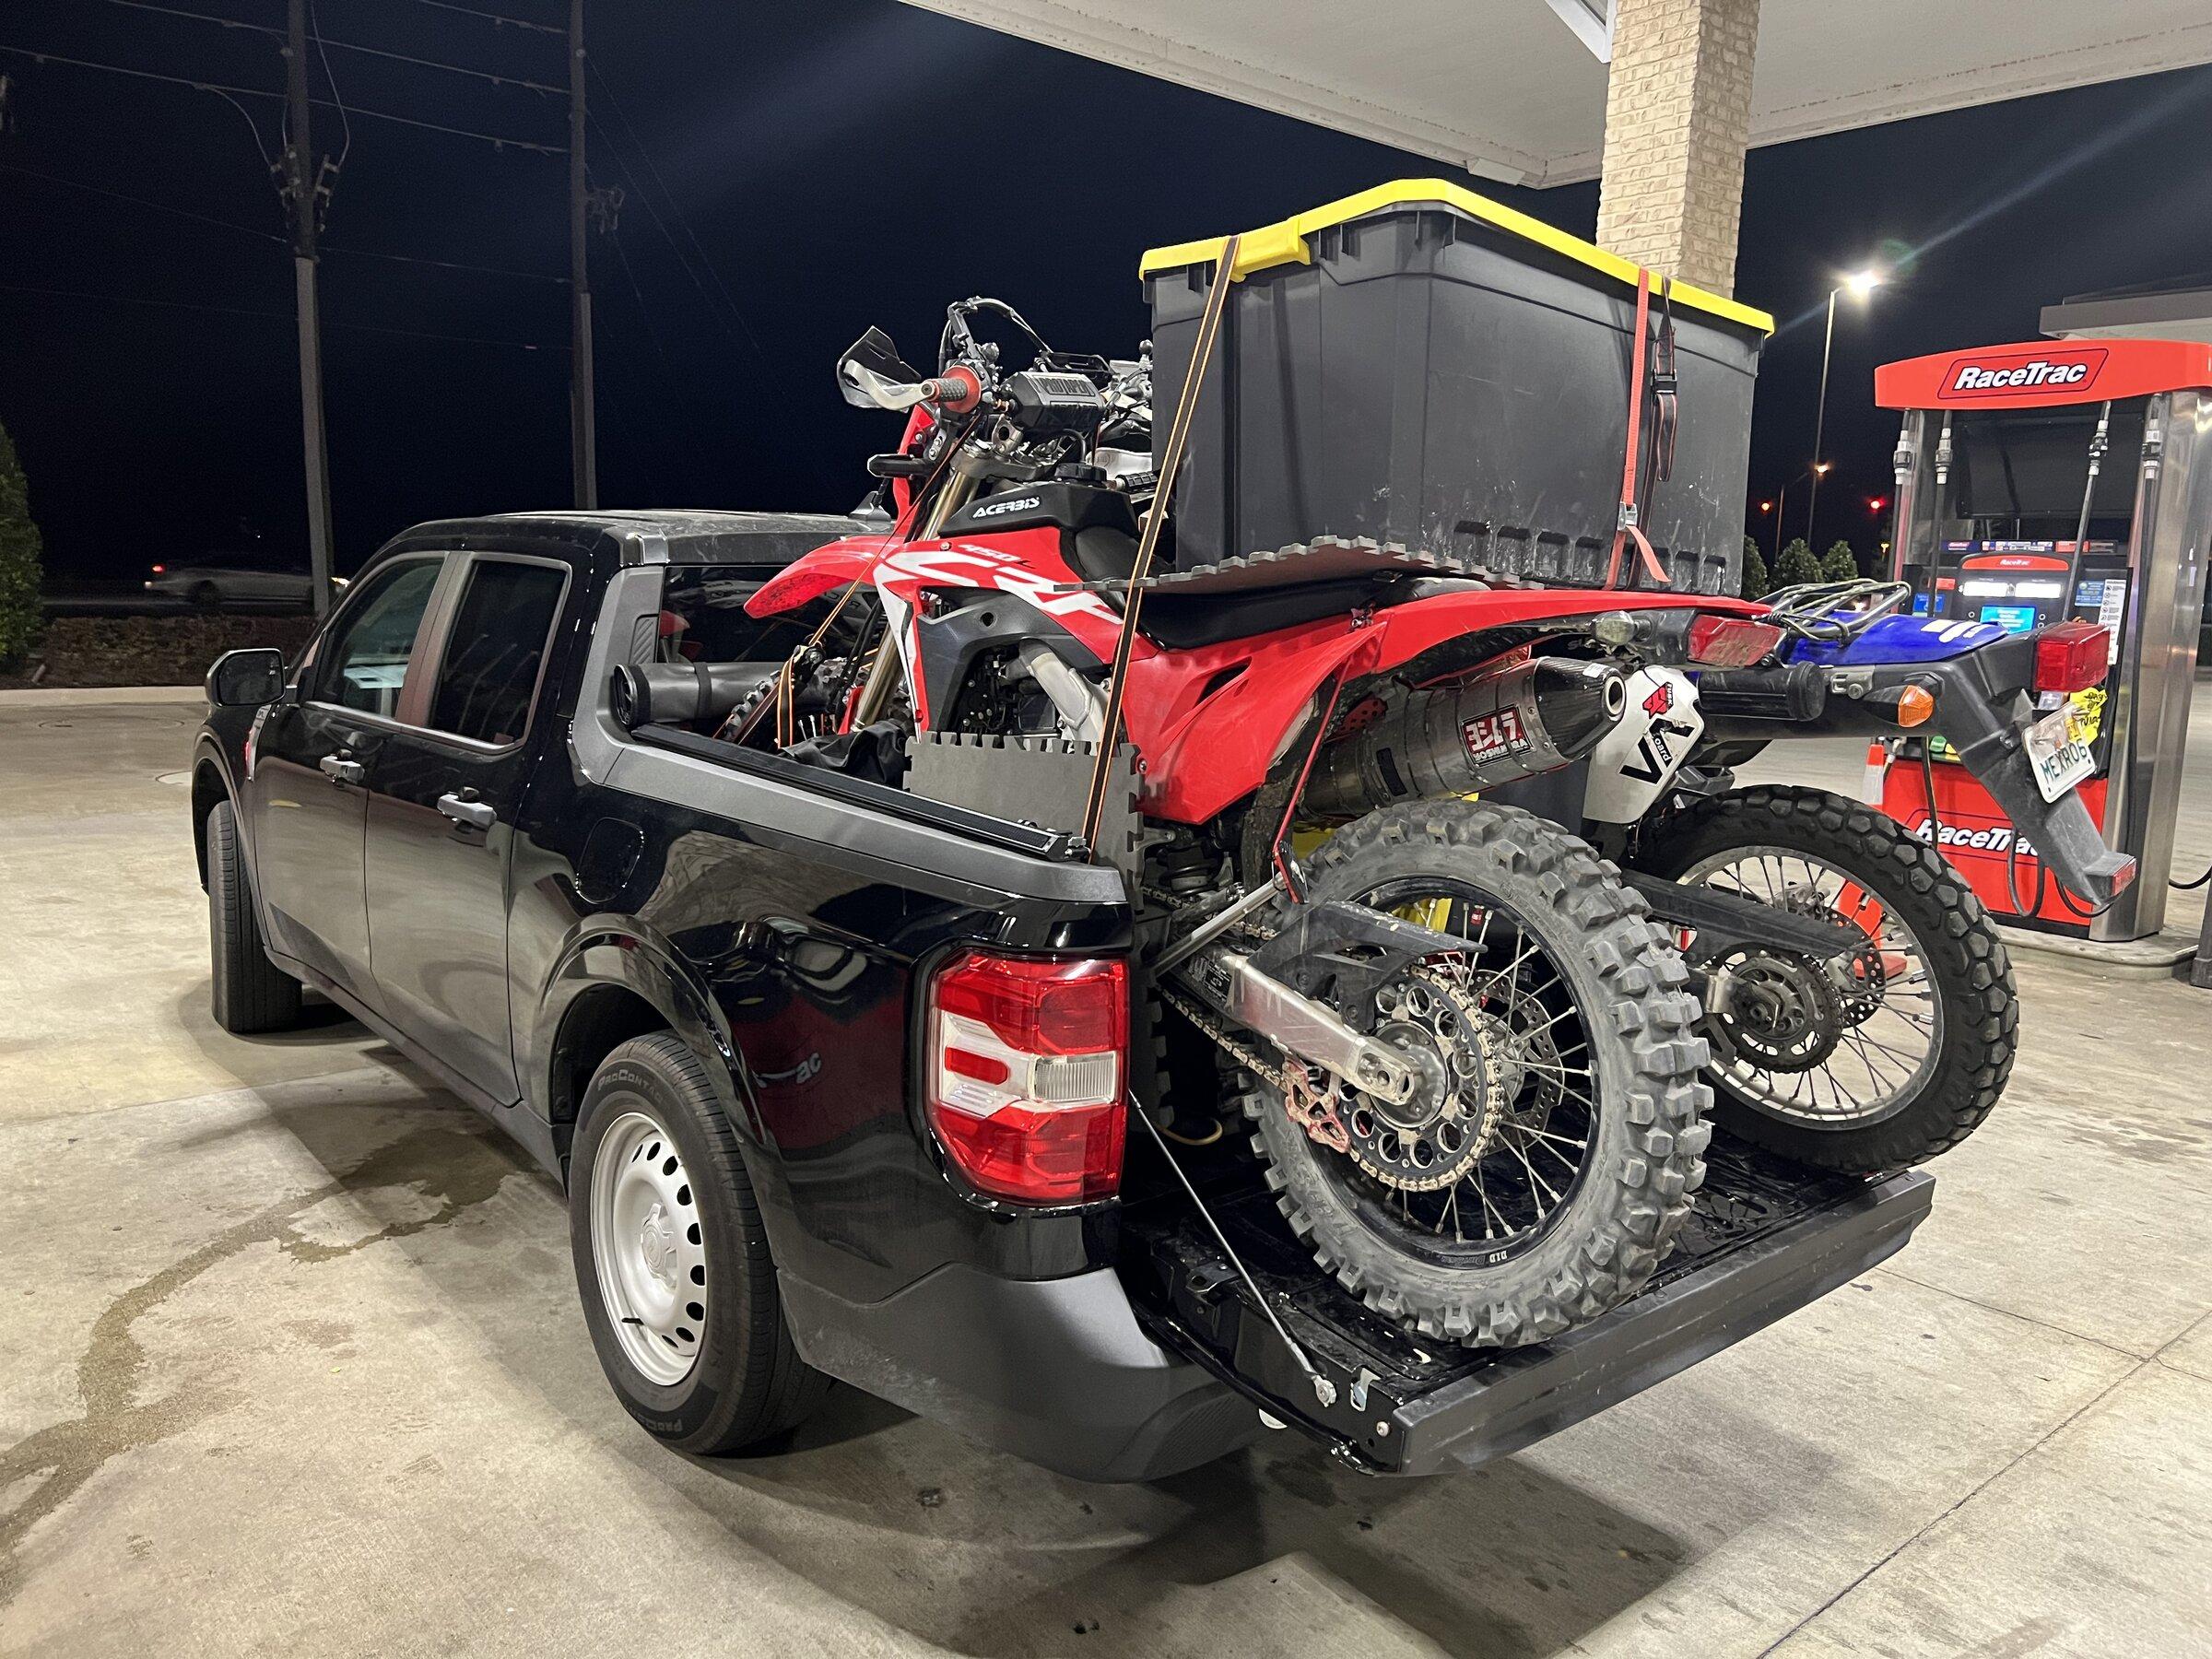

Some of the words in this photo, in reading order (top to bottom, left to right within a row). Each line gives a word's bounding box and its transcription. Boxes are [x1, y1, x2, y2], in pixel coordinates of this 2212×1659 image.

[1953, 360, 2088, 391] RaceTrac
[1472, 738, 1529, 761] YOSHIMRA
[1488, 1250, 1508, 1264] DID
